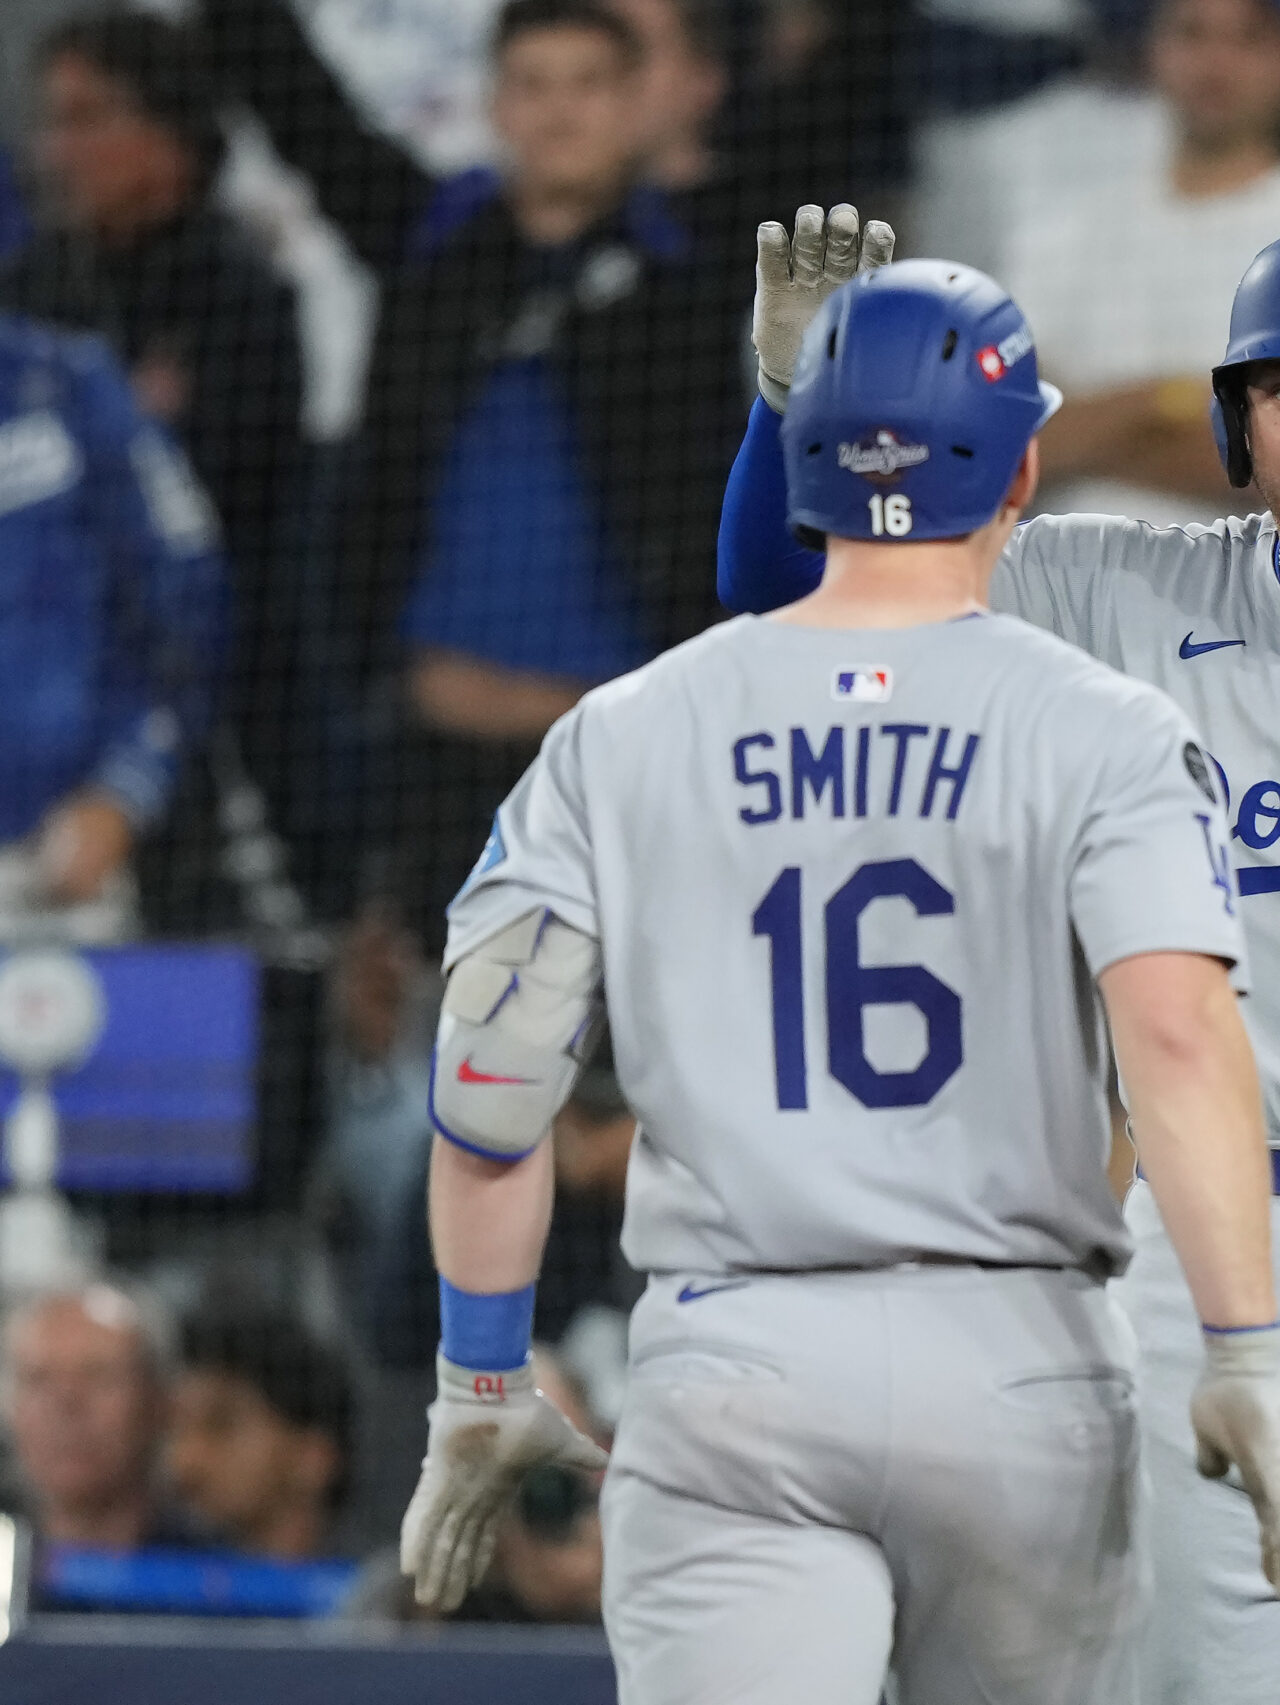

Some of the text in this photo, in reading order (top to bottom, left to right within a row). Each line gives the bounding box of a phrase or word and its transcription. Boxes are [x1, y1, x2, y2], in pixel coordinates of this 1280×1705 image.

[868, 493, 913, 537] 16
[732, 723, 981, 827] SMITH
[751, 857, 965, 1112] 16
